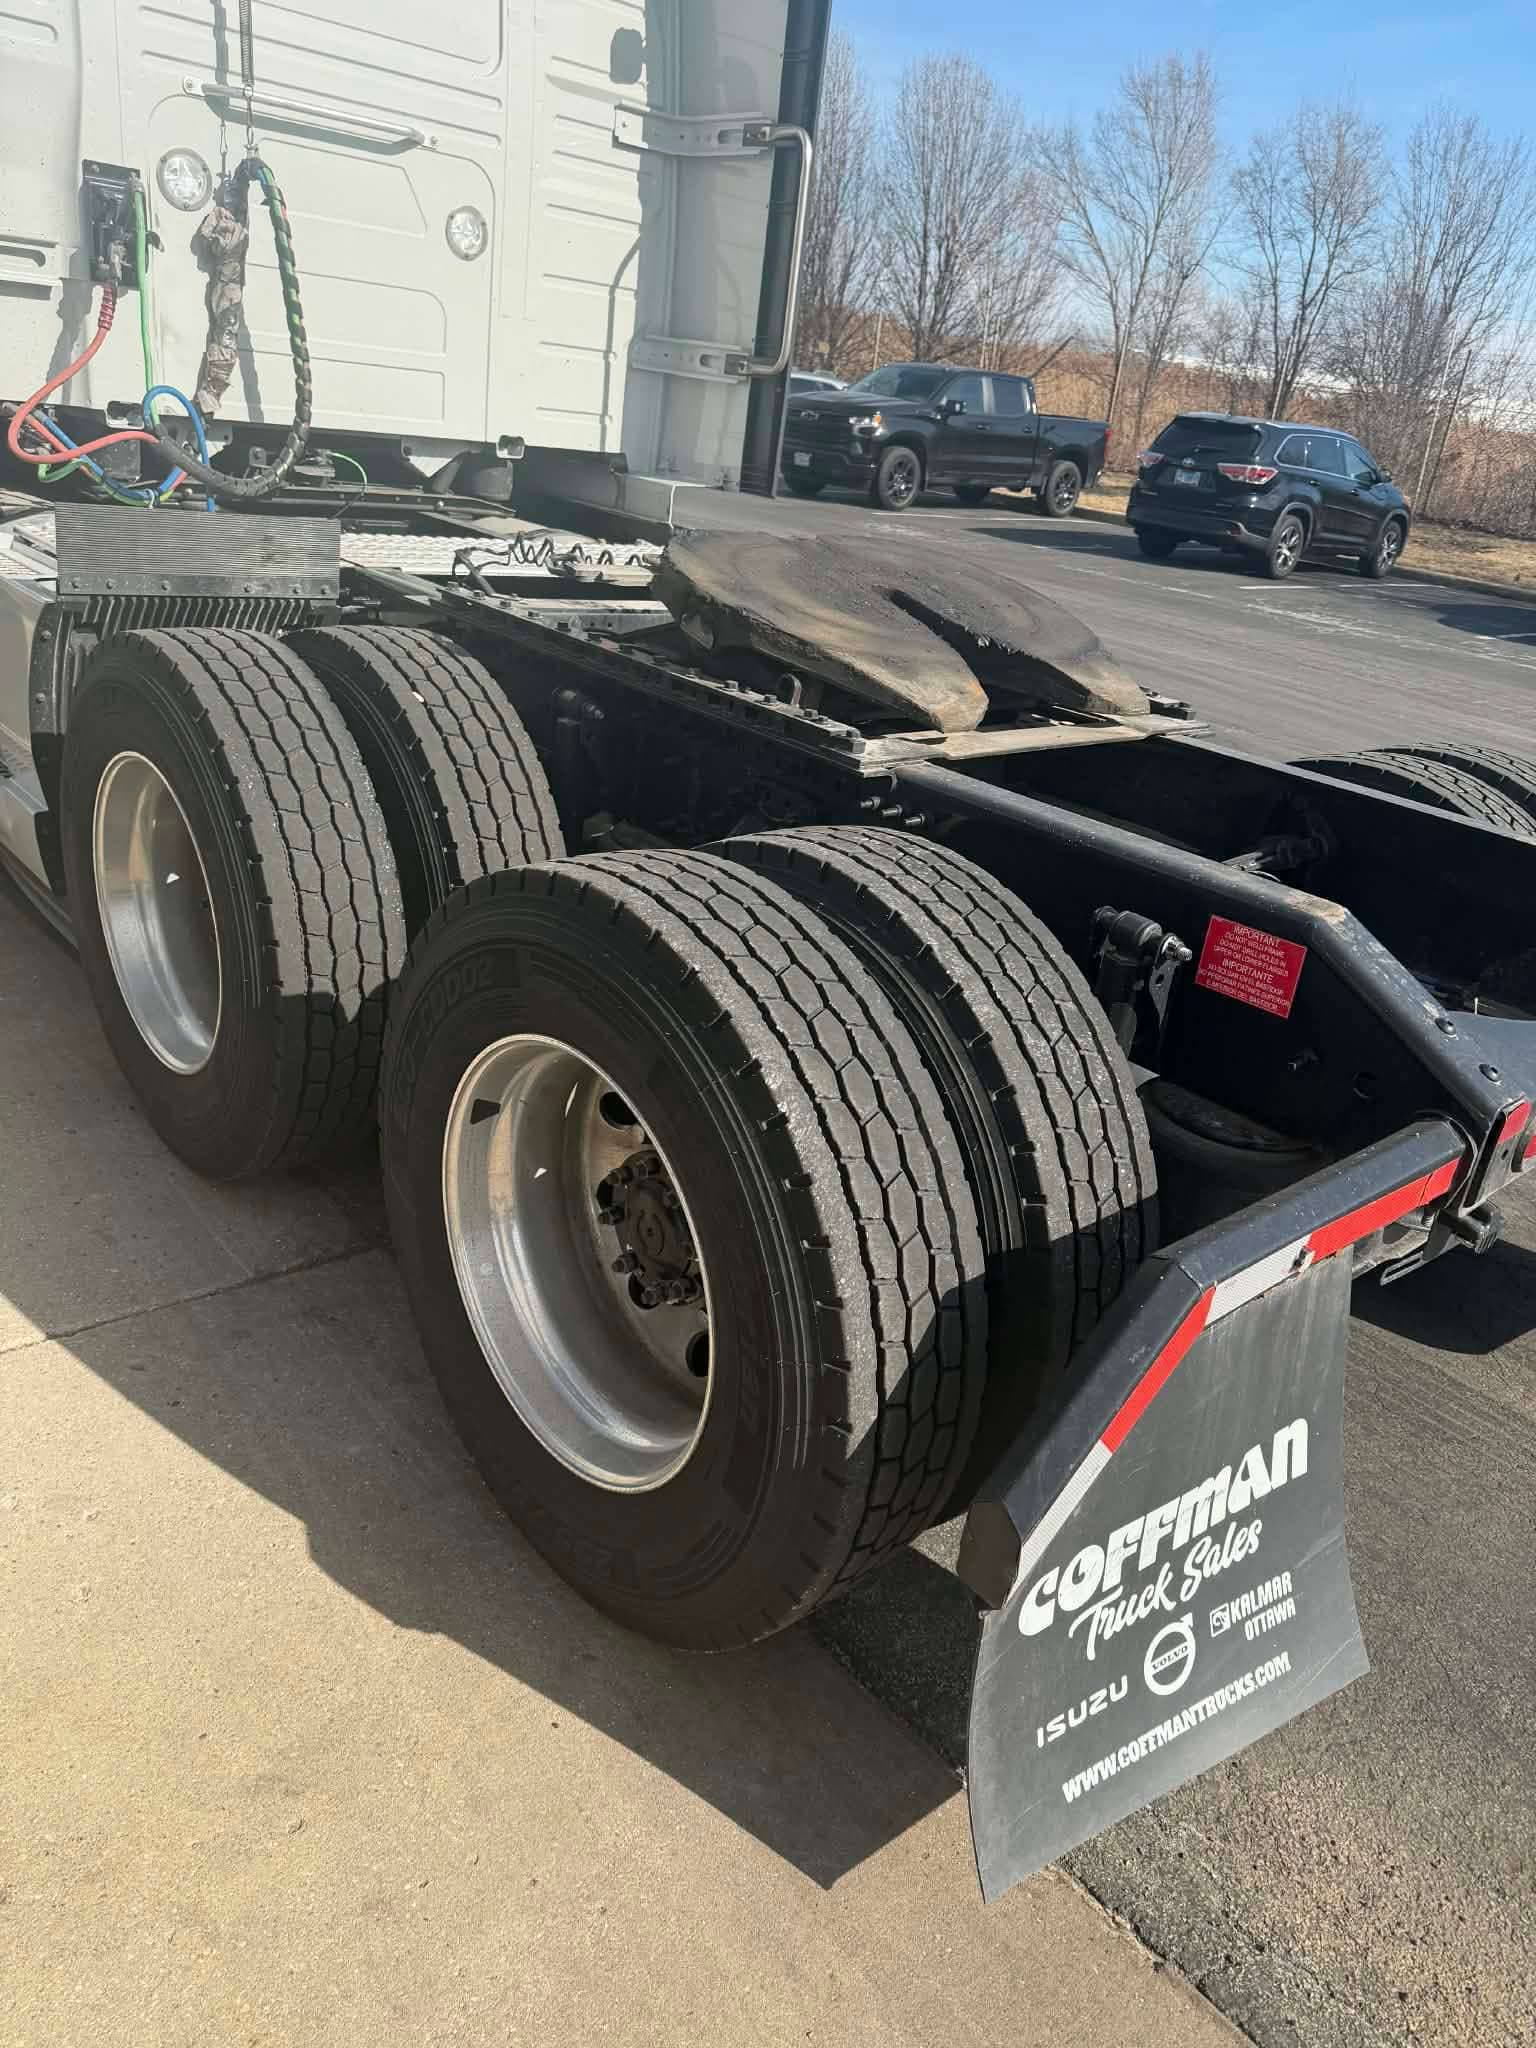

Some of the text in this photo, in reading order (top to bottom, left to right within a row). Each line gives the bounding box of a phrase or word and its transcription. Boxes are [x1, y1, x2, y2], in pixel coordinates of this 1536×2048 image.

[1233, 924, 1280, 948] IMPORTANT
[1221, 957, 1274, 984] IMPORTANTE
[1068, 1519, 1263, 1661] Truck Sales
[1230, 1571, 1293, 1624] KALMAR
[1244, 1597, 1296, 1641] OTTAWA
[1152, 1645, 1189, 1671] VOLVO
[1037, 1675, 1128, 1748] ISUZU
[1062, 1651, 1292, 1803] WWW.COFFMANTRUCKS.COM
